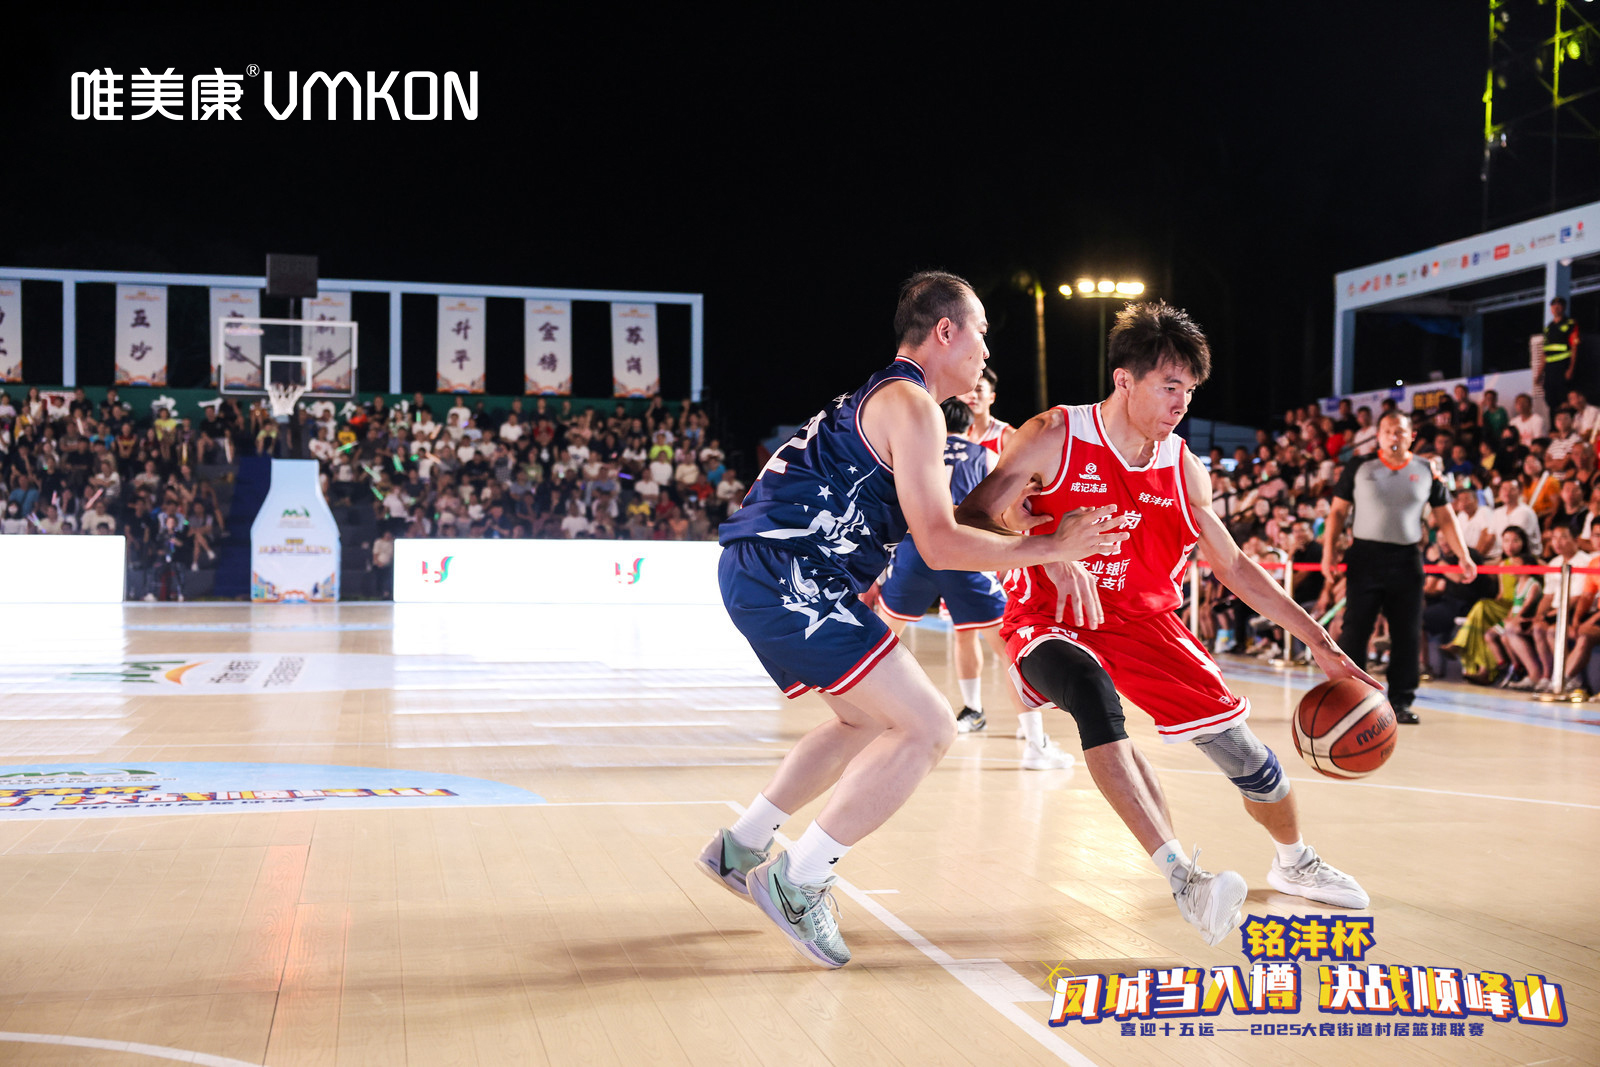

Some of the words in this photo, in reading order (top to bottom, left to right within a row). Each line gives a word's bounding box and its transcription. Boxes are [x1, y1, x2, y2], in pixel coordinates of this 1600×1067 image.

[451, 318, 472, 371] 升平
[1070, 482, 1108, 494] 成记冻品
[1138, 491, 1175, 508] 铭沣杯
[1094, 573, 1127, 592] 支行
